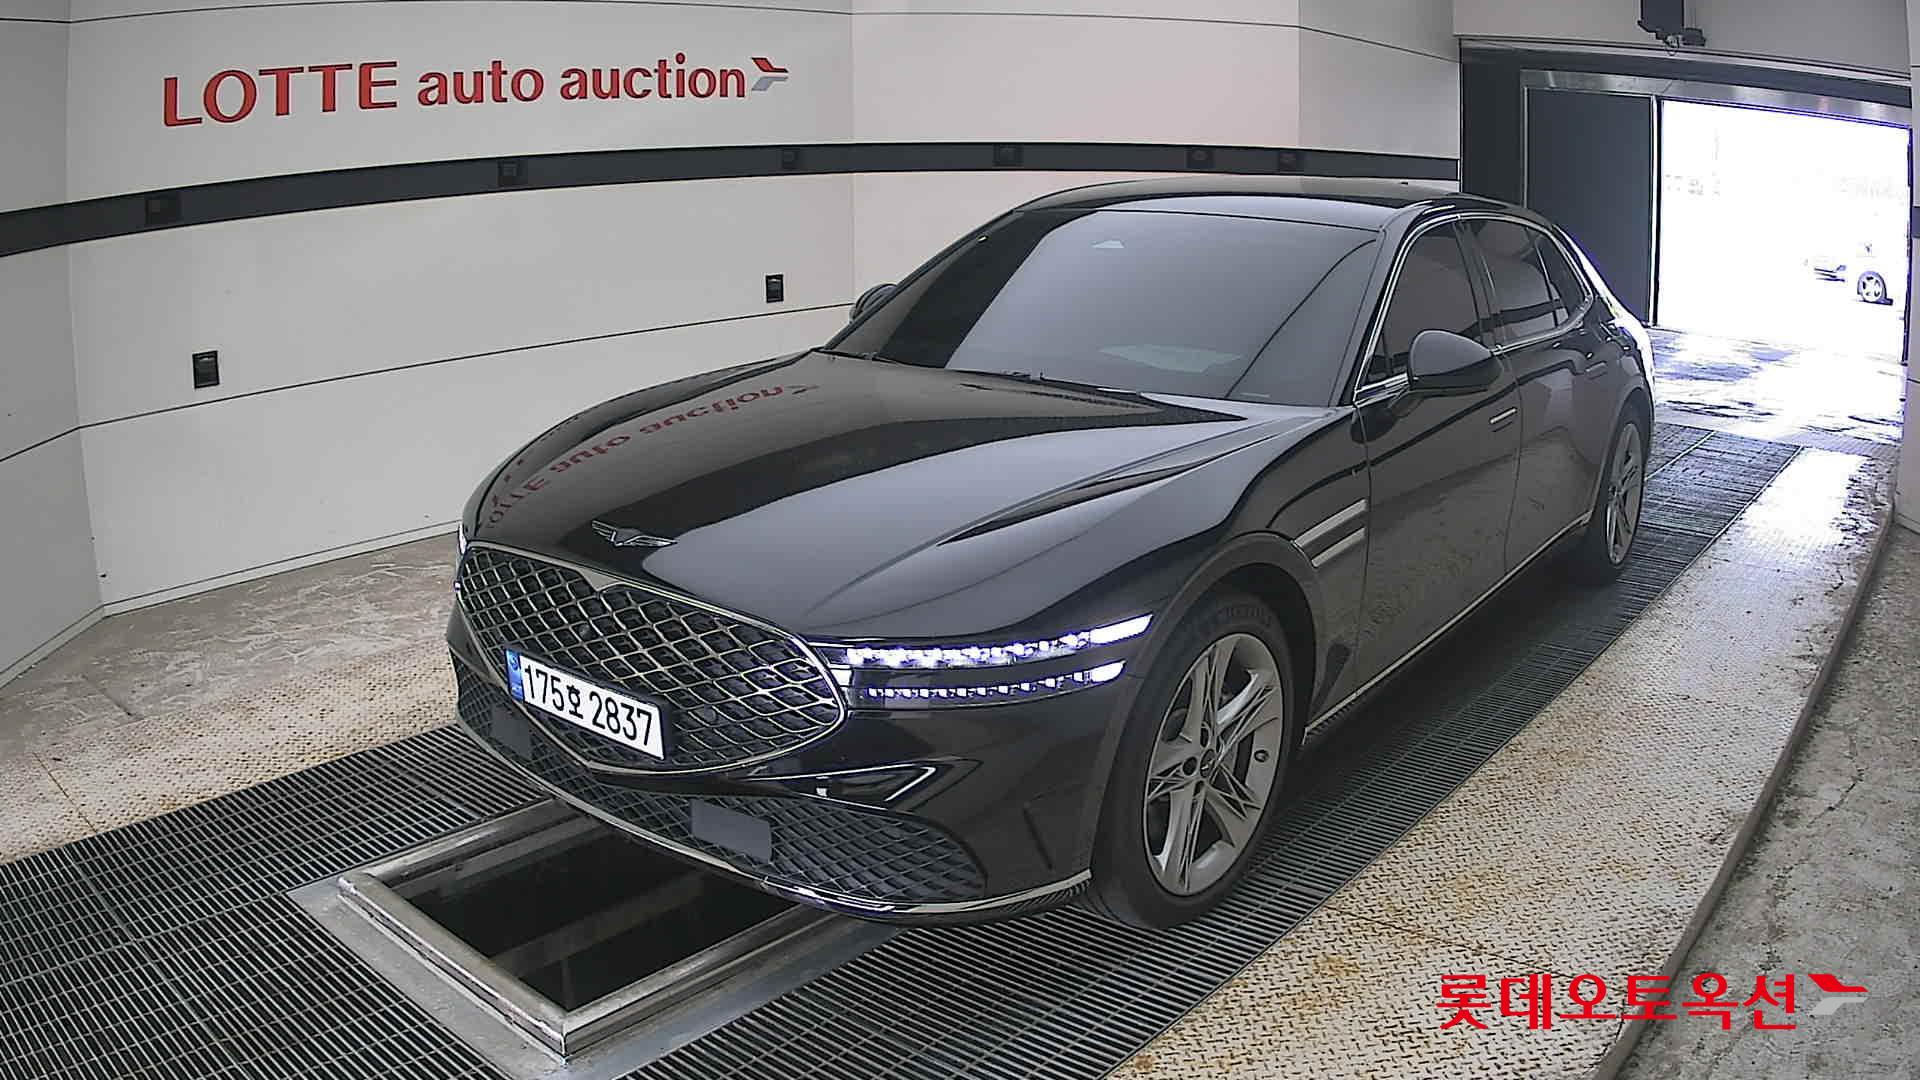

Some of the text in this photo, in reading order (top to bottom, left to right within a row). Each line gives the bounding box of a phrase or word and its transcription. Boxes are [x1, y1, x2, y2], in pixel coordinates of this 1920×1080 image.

[164, 52, 746, 126] LOTTE auto auction
[524, 664, 652, 746] 175호 2837
